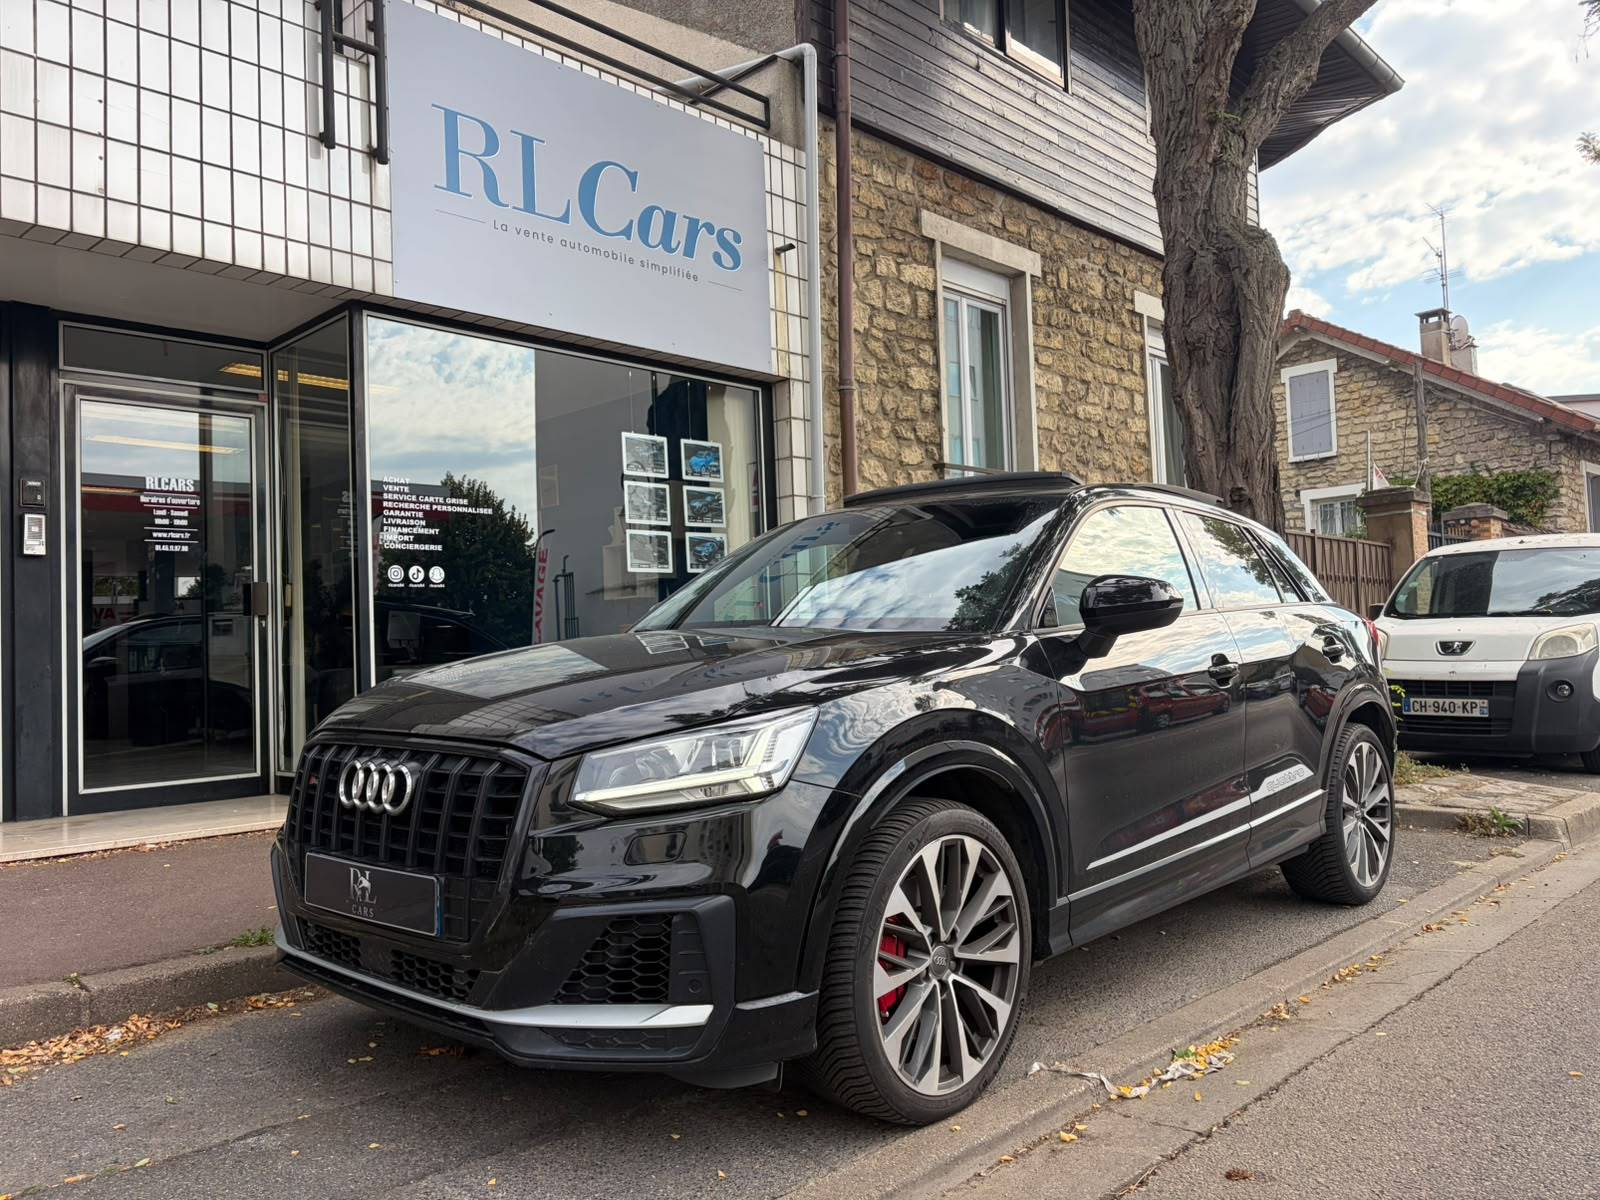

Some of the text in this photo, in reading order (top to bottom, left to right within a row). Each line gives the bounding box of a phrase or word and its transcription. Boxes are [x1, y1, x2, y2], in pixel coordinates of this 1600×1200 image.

[431, 103, 744, 273] RLCars
[493, 219, 699, 282] La vente automobile simplifiée
[145, 476, 194, 492] RLCARS
[383, 476, 410, 484] ACHAT
[383, 484, 409, 493] VENTE
[383, 493, 469, 505] SERVICE CARTE GRISE
[383, 501, 431, 510] RECHERCHE
[383, 509, 424, 518] GARANTIE
[383, 517, 426, 526] LIVRAISON
[383, 526, 440, 535] FINANCEMENT
[384, 533, 414, 542] IMPORT
[384, 542, 443, 551] CONCIERGERIE
[1411, 700, 1479, 715] CH-940-KP
[351, 903, 375, 918] CARS
